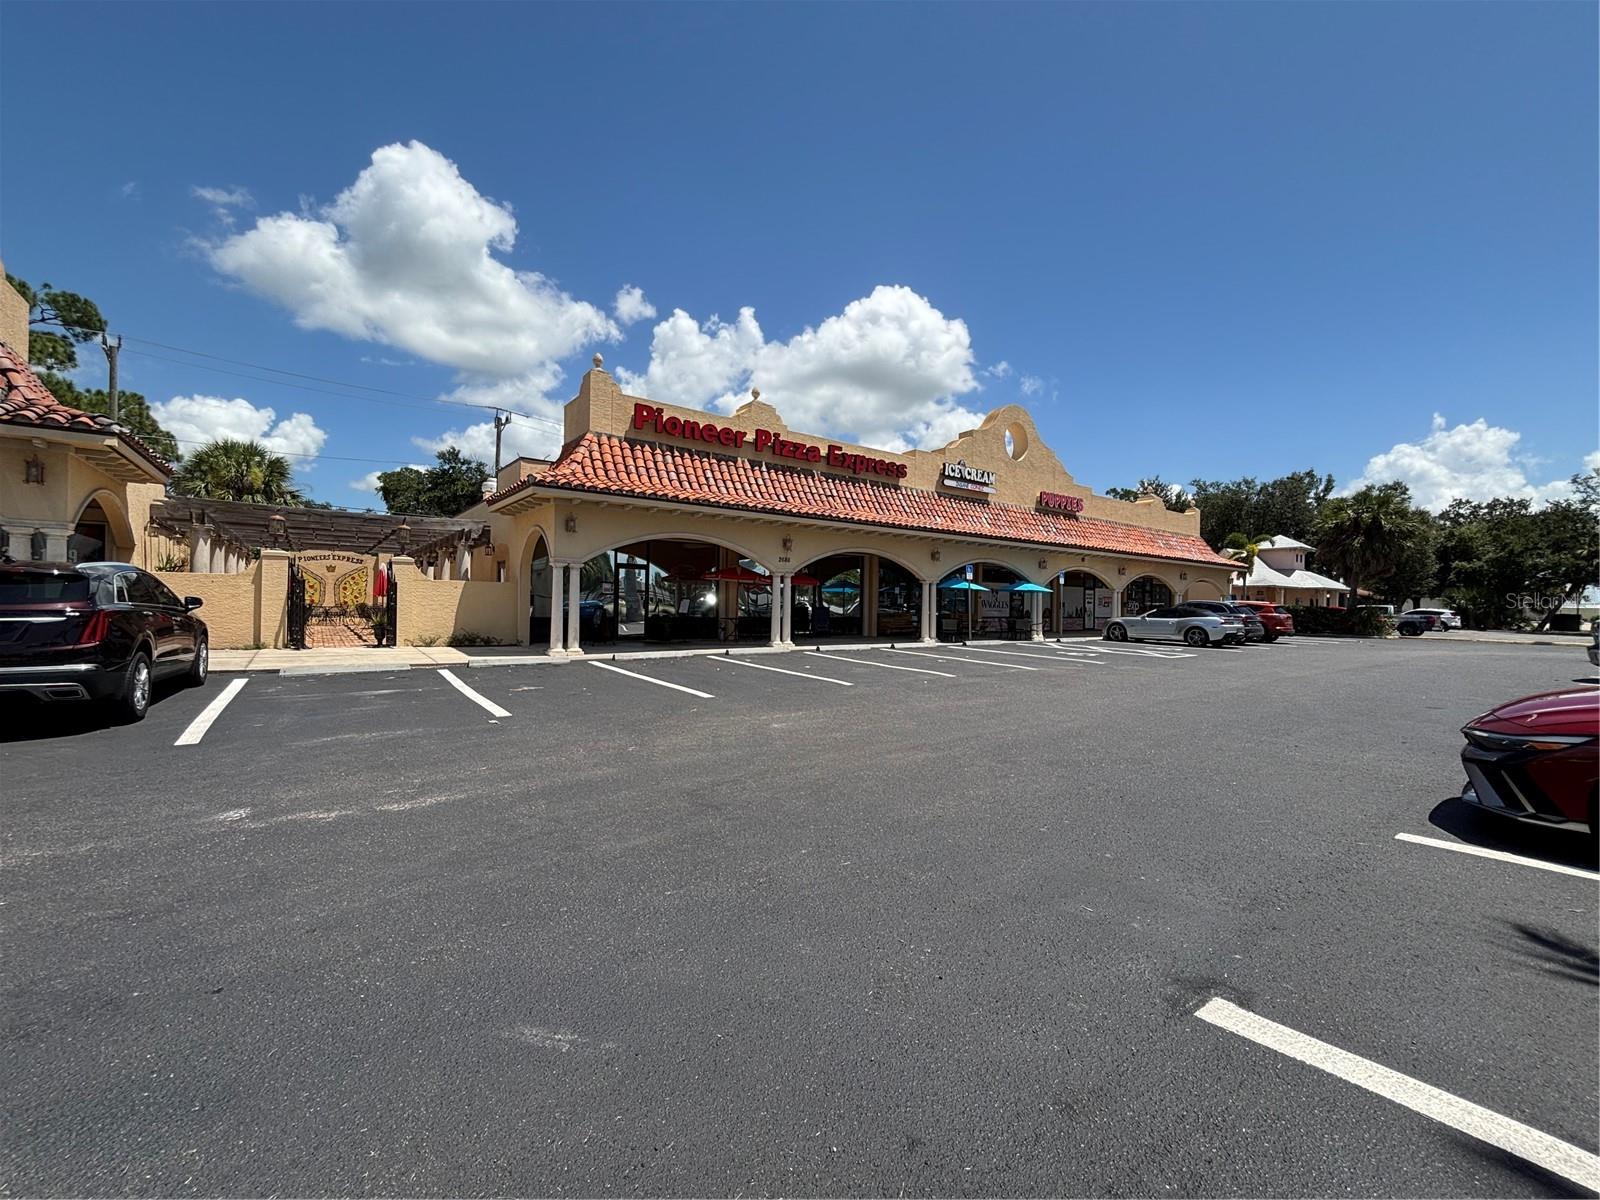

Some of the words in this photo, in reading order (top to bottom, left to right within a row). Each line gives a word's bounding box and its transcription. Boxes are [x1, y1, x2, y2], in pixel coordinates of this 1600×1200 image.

[634, 403, 747, 448] Pioneer
[755, 429, 821, 462] Pizza
[827, 445, 907, 478] Express
[945, 463, 961, 478] ICE
[965, 468, 996, 484] CREAM
[1041, 492, 1084, 513] PUPPIES
